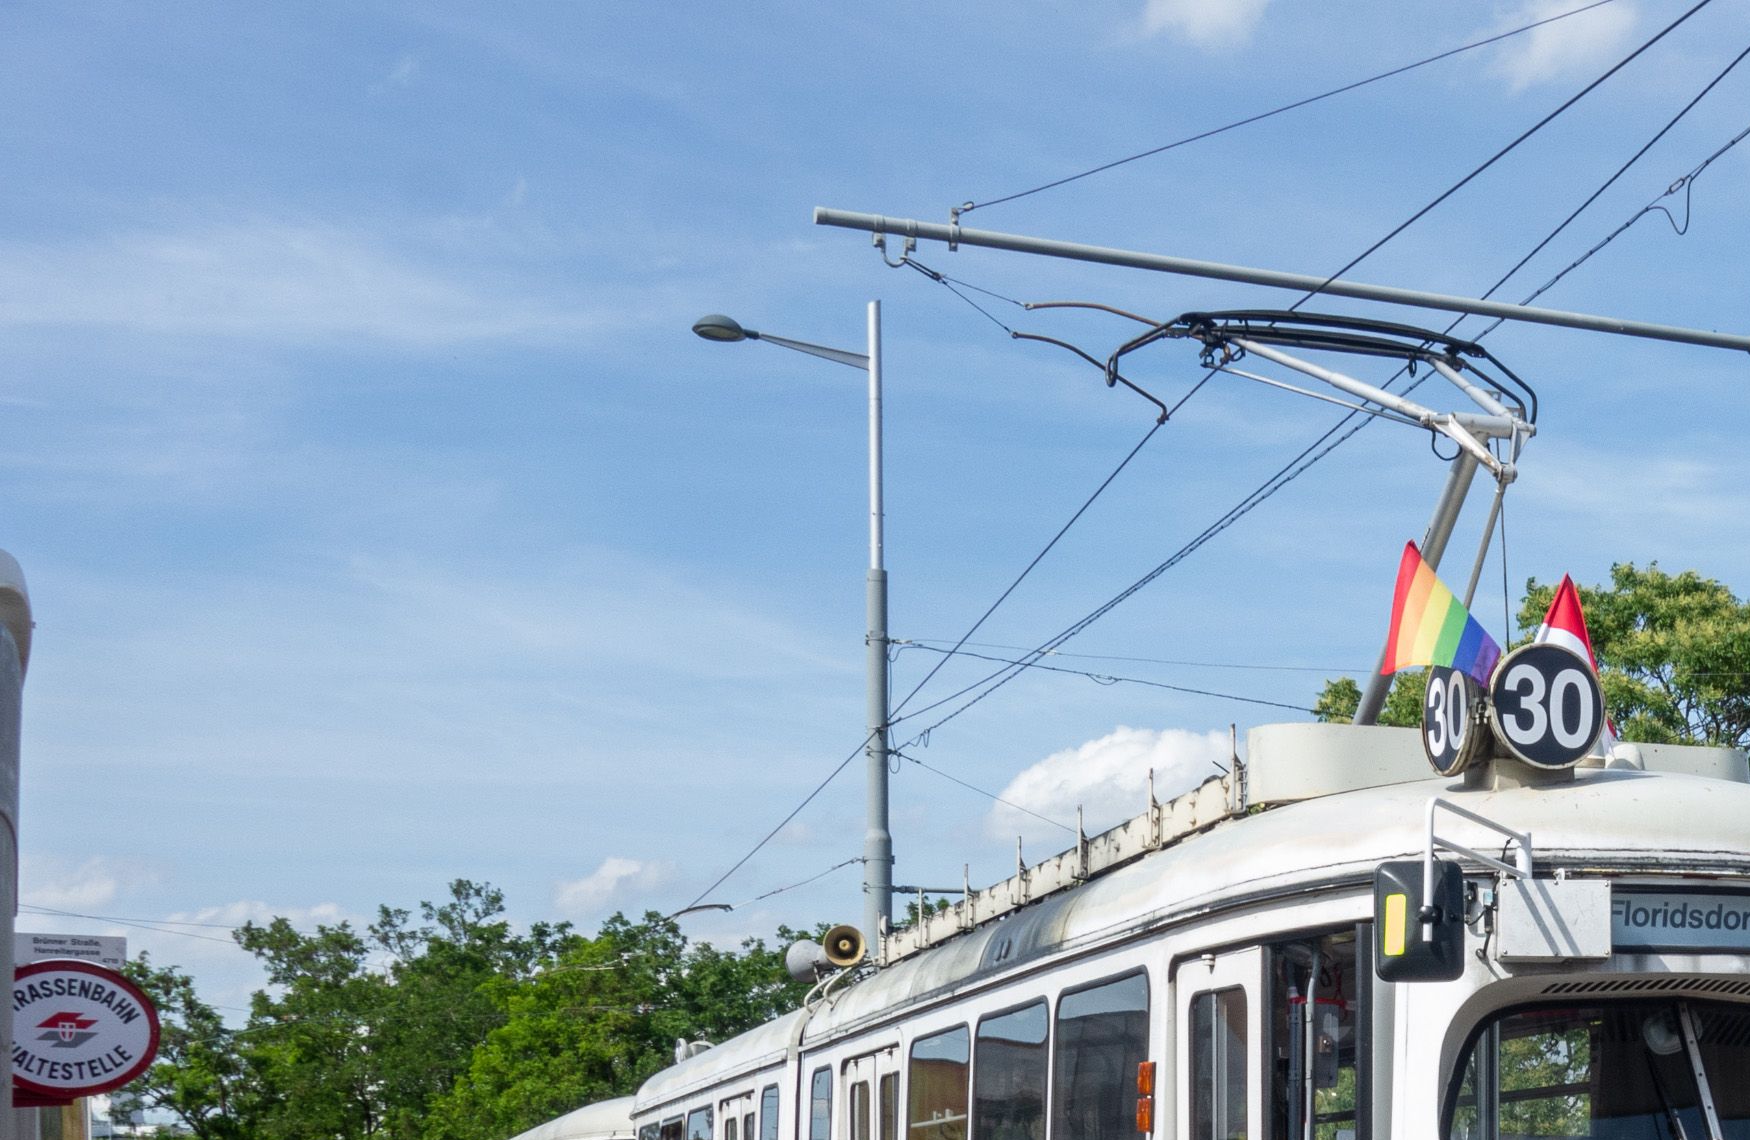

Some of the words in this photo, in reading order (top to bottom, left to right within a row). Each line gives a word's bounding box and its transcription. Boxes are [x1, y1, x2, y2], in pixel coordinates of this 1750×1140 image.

[1427, 669, 1467, 757] 30
[1502, 663, 1594, 749] 30
[13, 978, 141, 1024] RASSENBAHN
